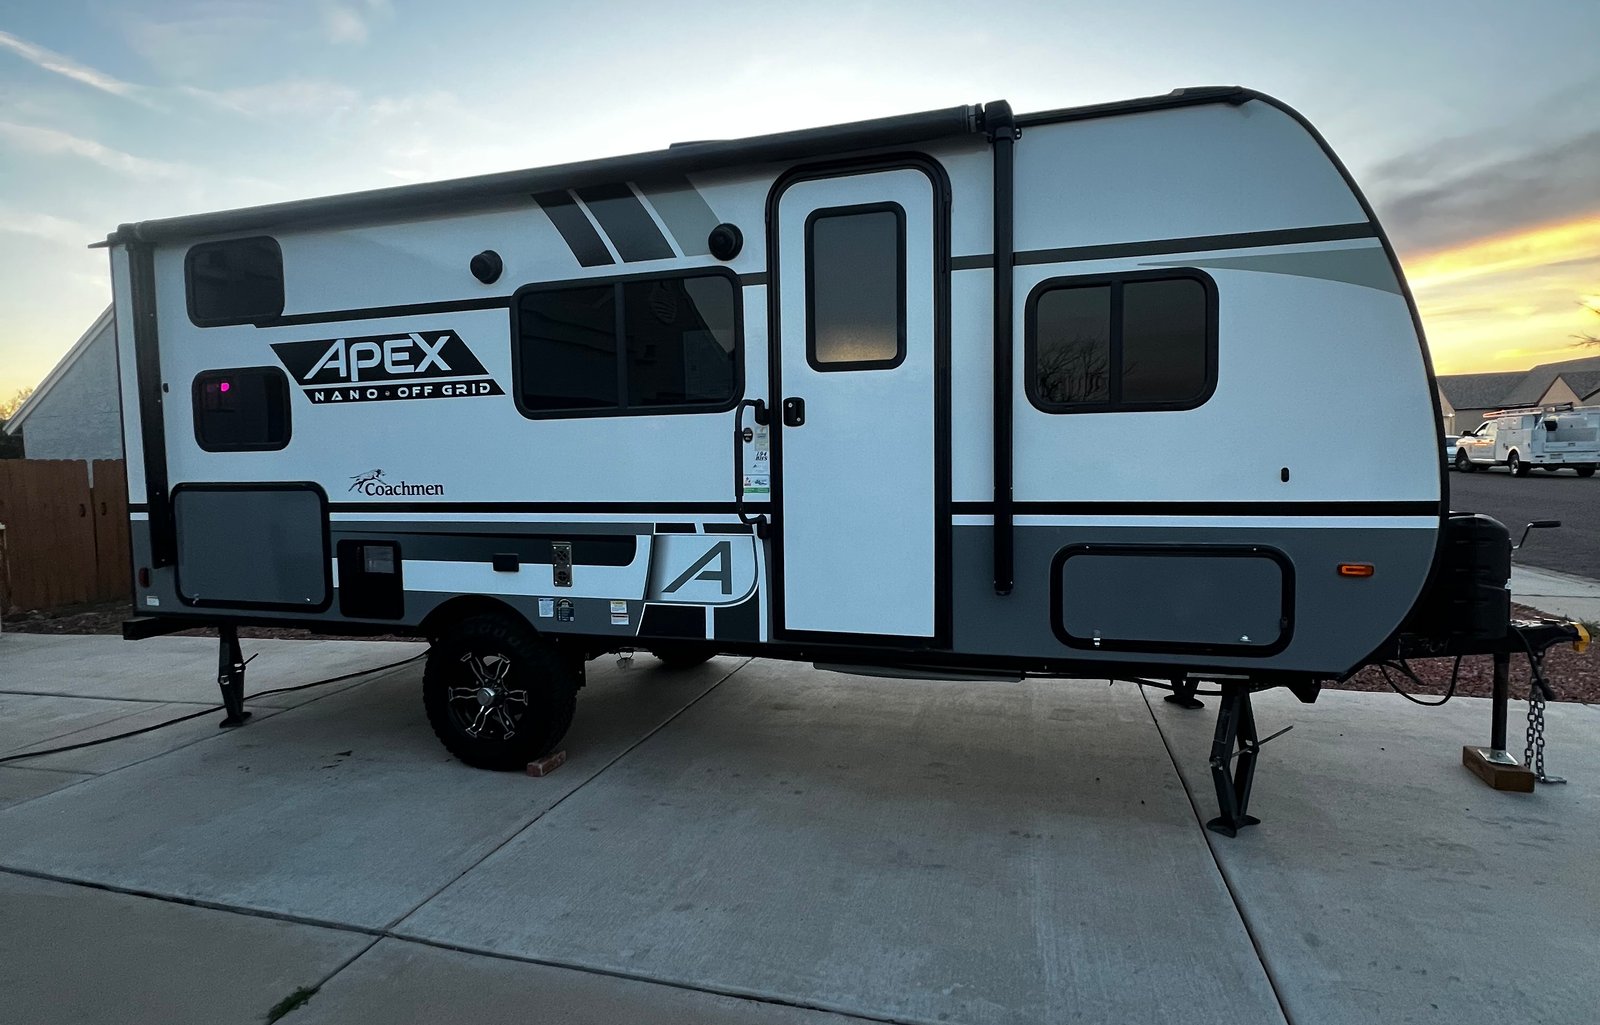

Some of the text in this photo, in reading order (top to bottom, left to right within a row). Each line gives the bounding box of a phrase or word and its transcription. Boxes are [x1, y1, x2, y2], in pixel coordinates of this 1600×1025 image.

[303, 333, 452, 382] APEX
[315, 382, 491, 401] NANO OFF GRID
[365, 481, 444, 496] Coachmen
[661, 541, 733, 595] A
